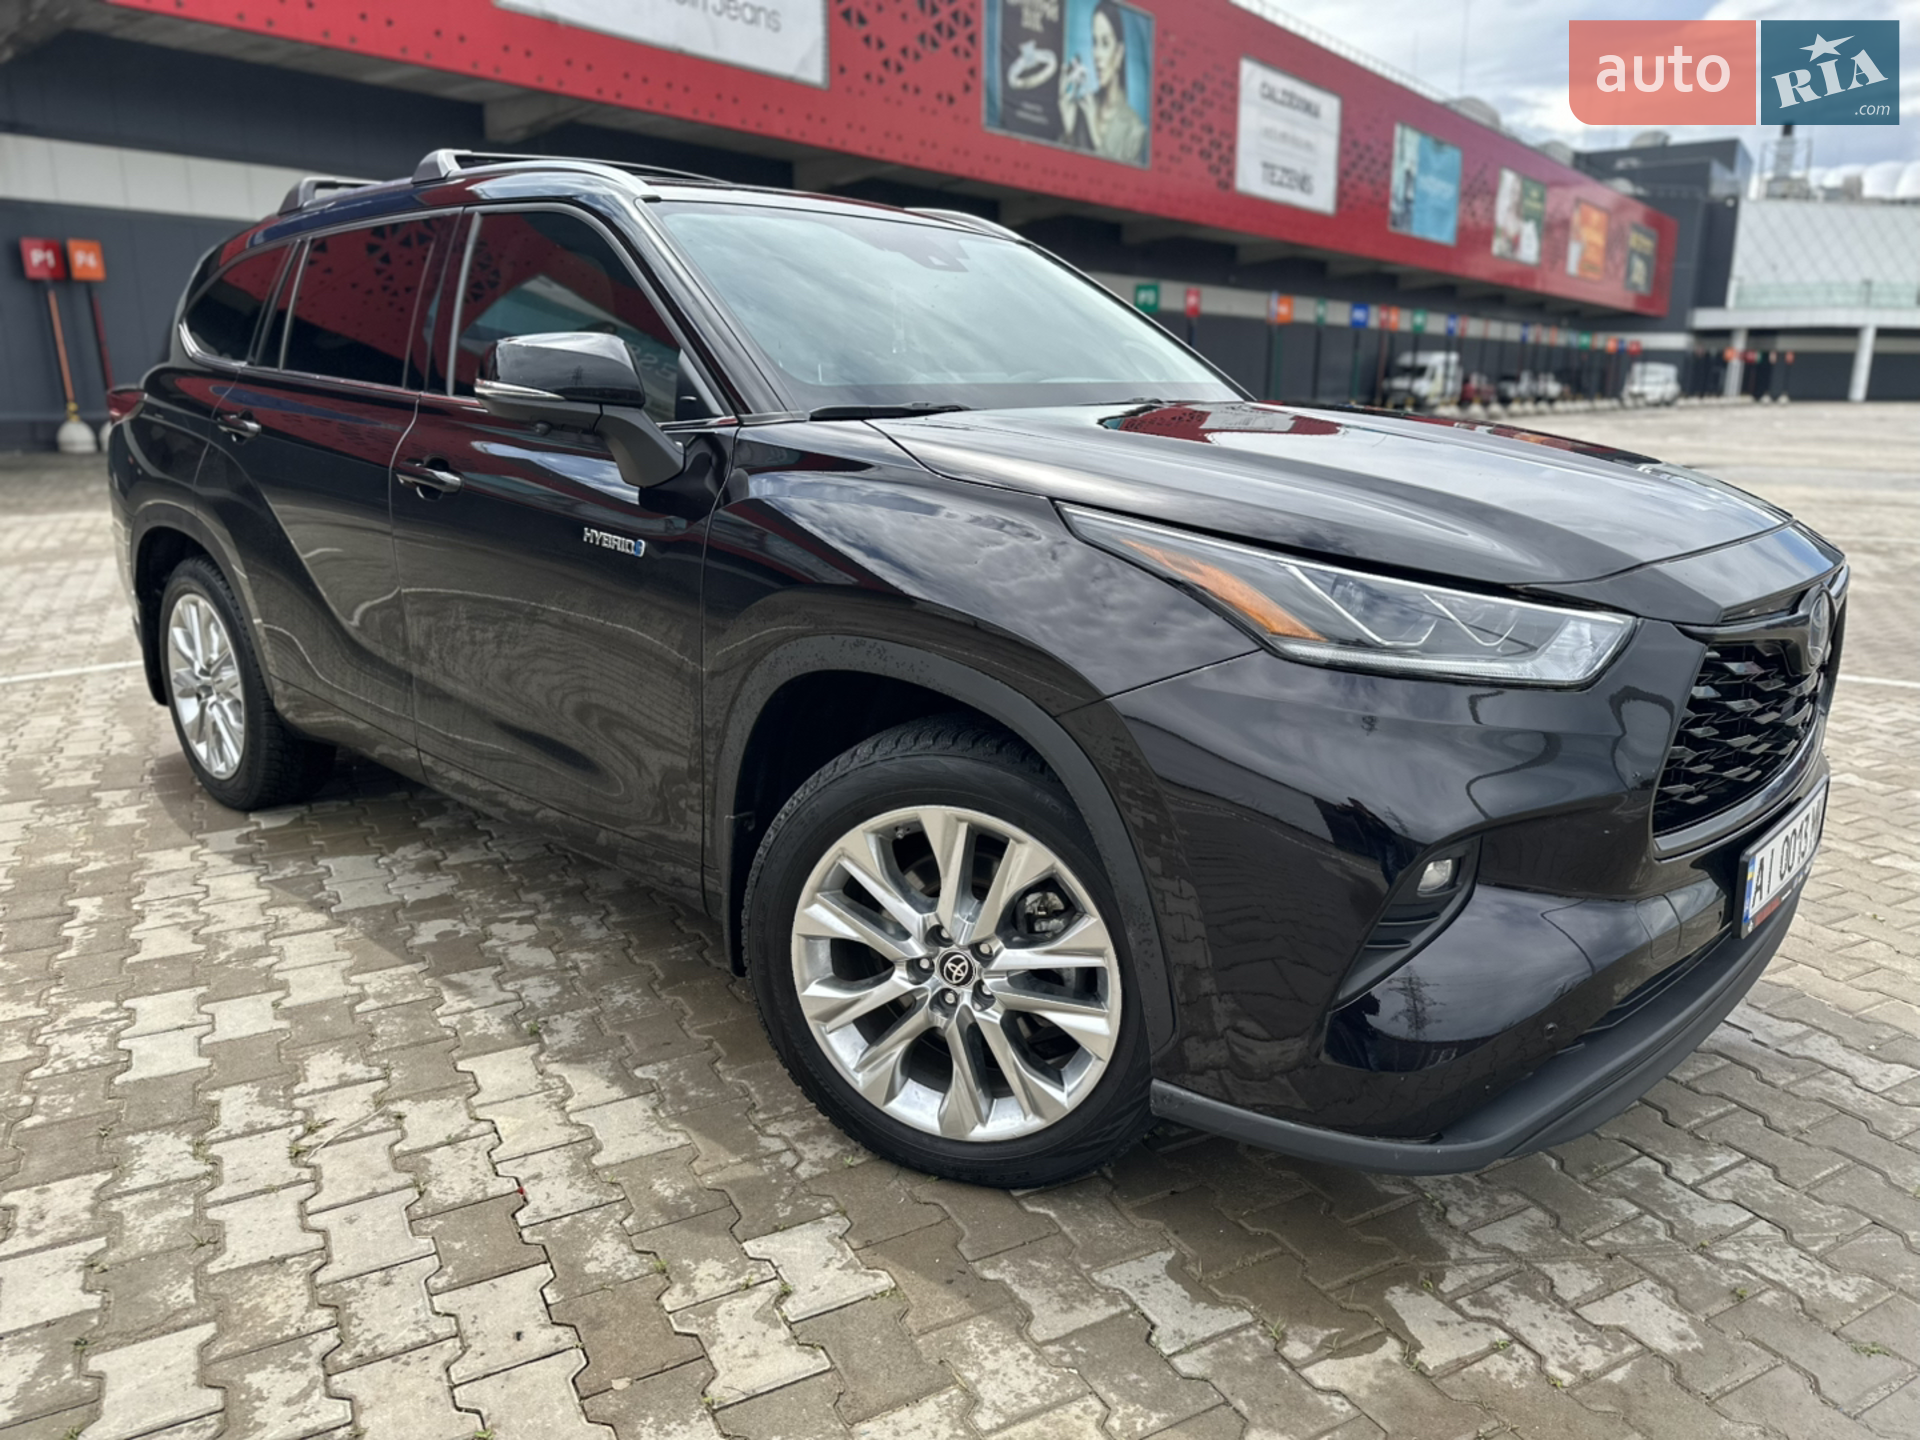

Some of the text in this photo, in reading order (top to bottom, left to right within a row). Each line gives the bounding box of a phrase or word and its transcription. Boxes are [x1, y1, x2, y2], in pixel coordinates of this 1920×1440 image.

[711, 0, 782, 33] Jeans
[583, 527, 636, 555] HYBRID
[1751, 848, 1775, 908] AI
[1779, 812, 1811, 882] 0013
